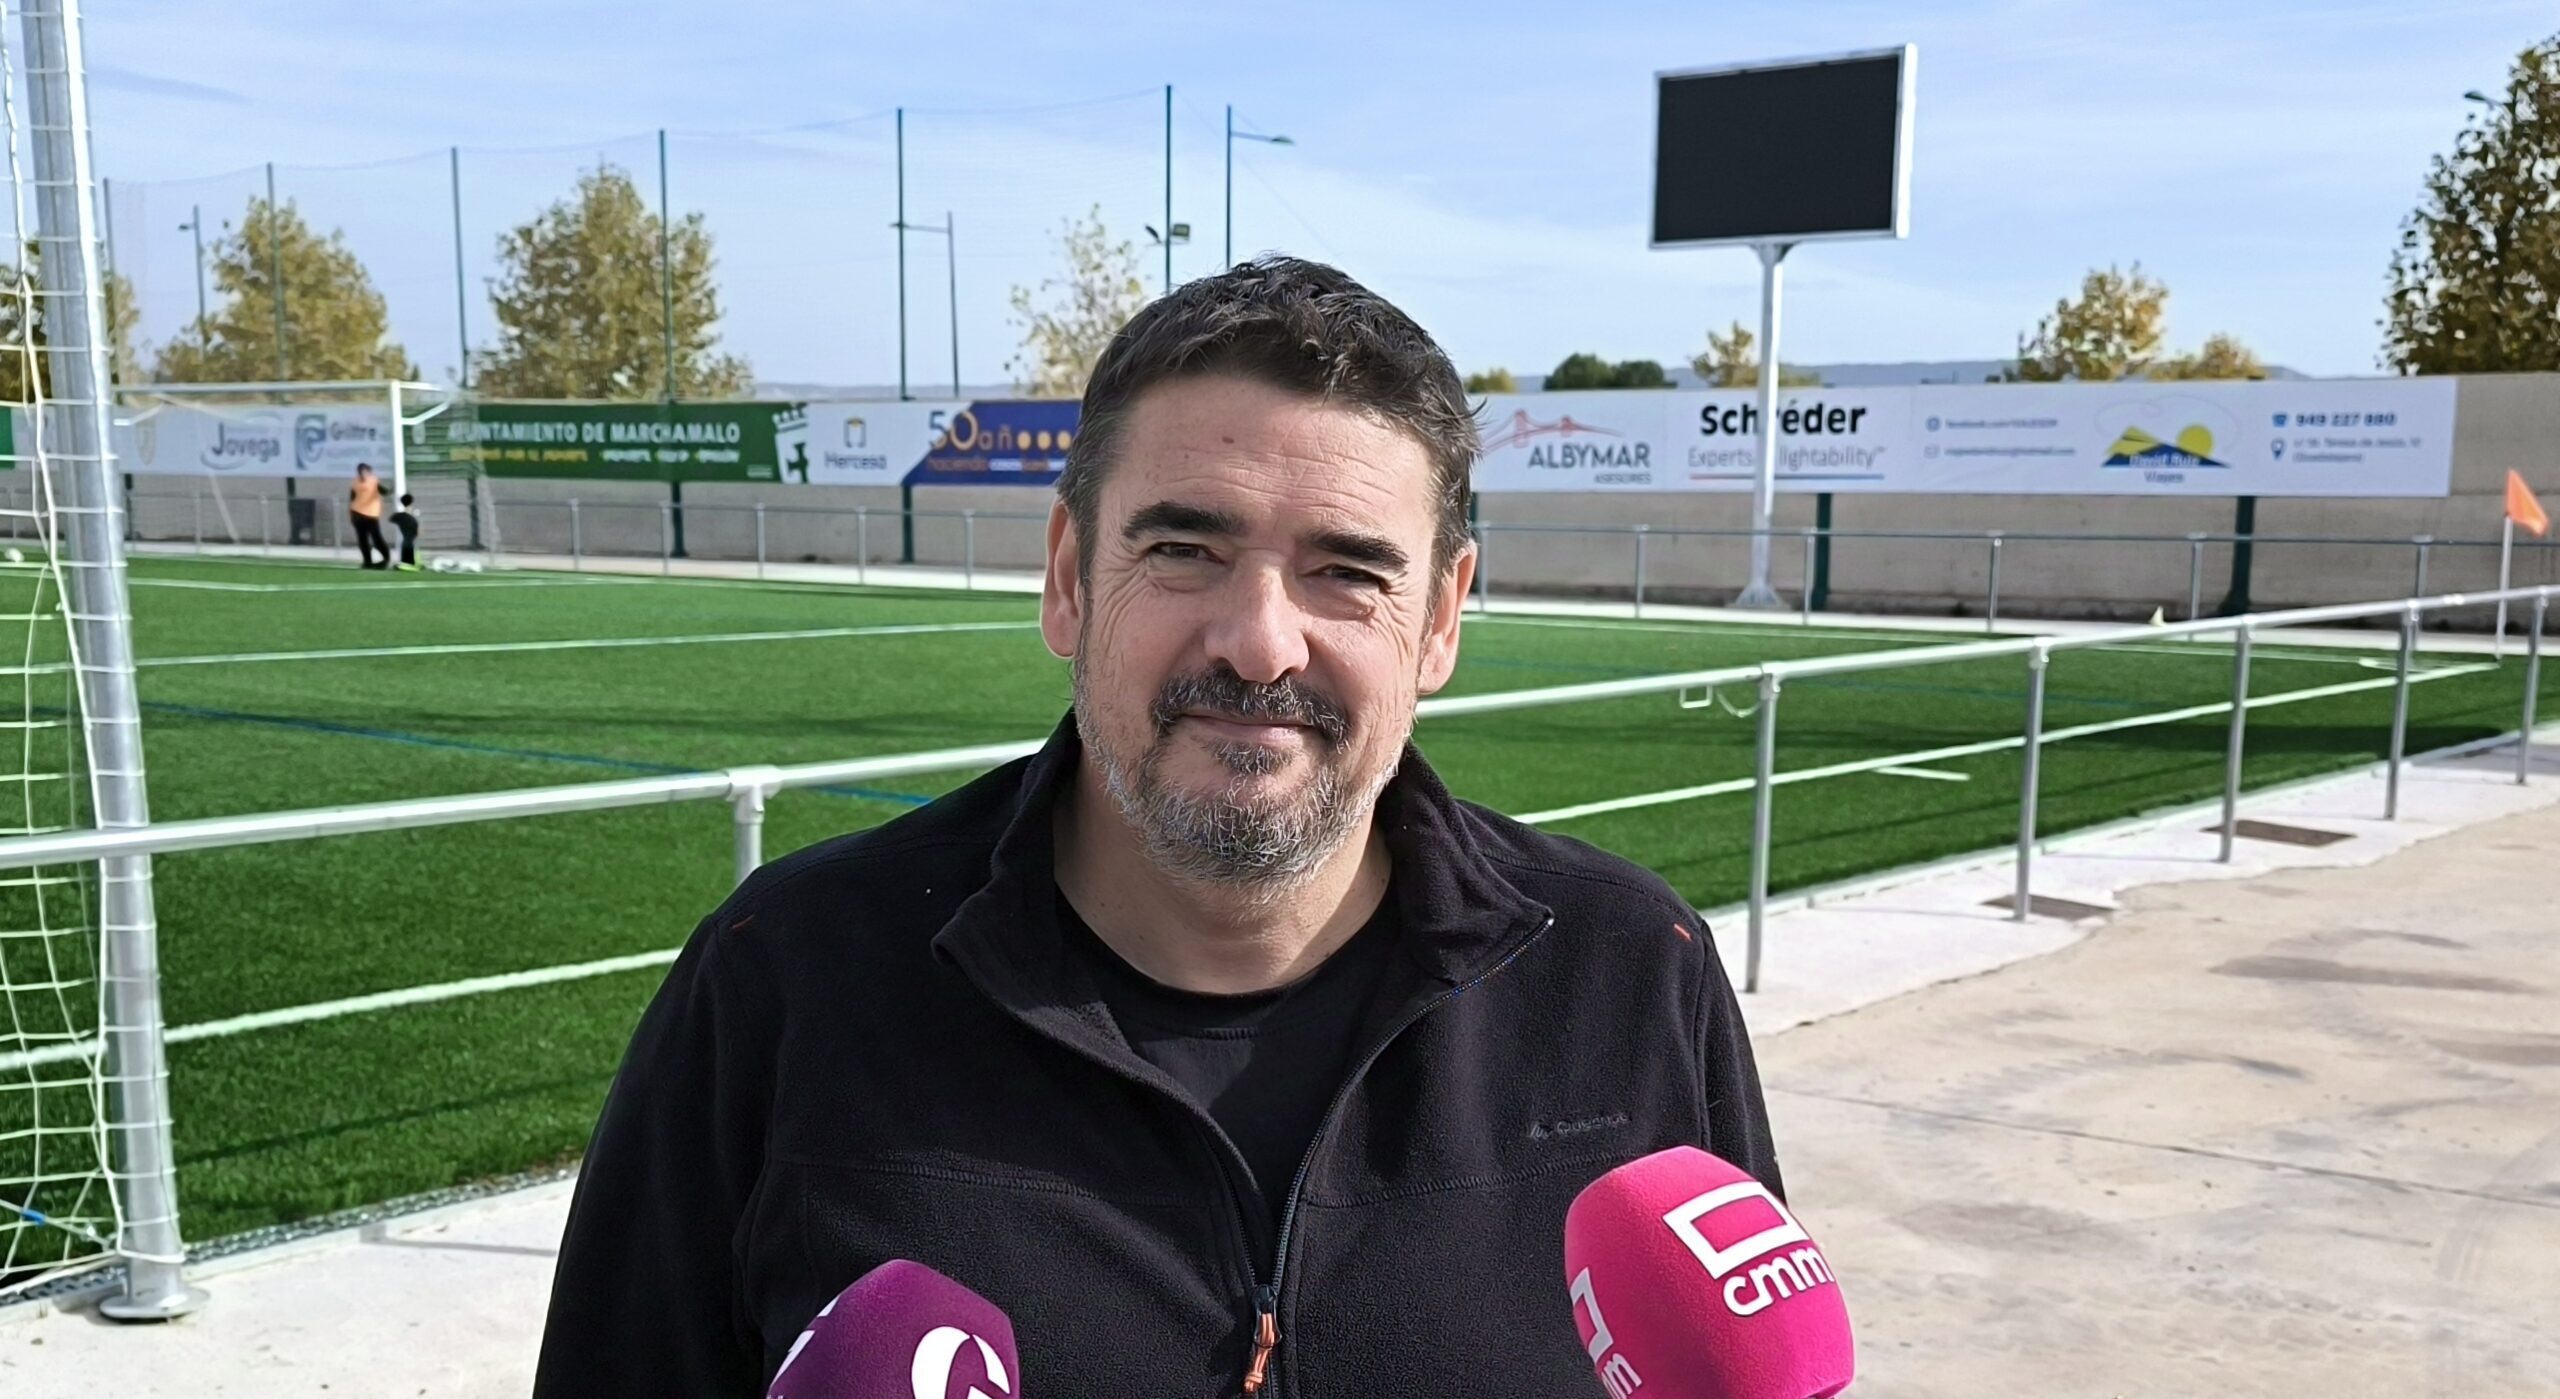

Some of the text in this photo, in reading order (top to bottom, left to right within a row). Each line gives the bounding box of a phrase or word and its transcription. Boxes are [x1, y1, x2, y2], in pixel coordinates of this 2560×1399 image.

[1700, 398, 1867, 435] Schéder
[581, 421, 605, 443] DE
[610, 421, 741, 443] MARCHAMALO
[824, 453, 887, 470] Hercesa
[1527, 442, 1651, 469] ALBYMAR
[1688, 447, 1752, 468] Experts
[1723, 1246, 1836, 1317] cmm
